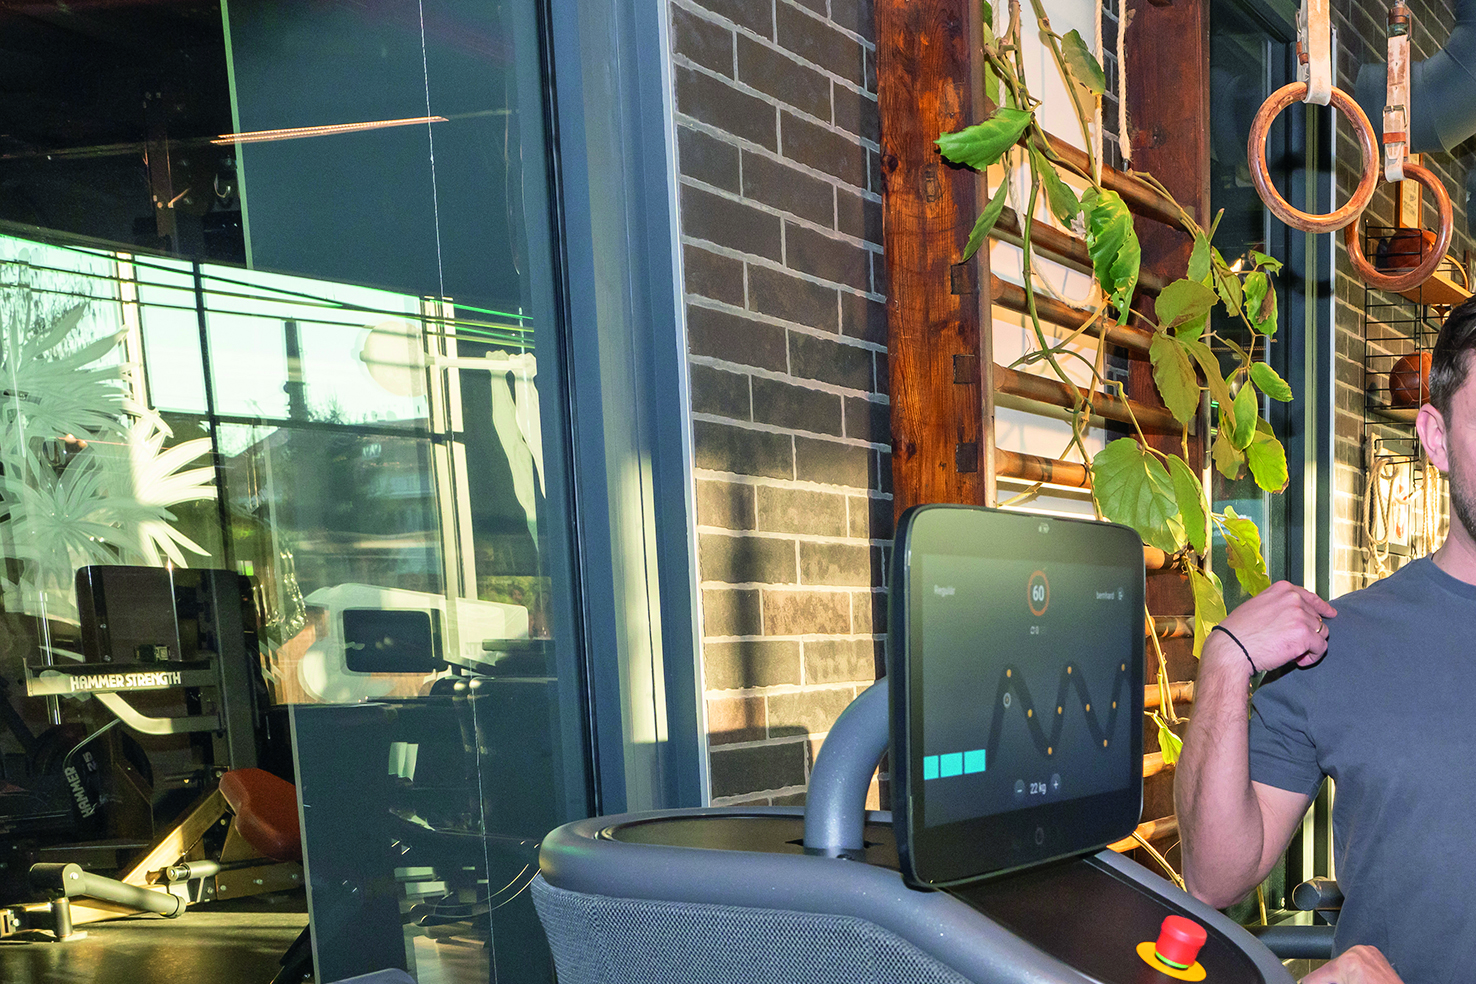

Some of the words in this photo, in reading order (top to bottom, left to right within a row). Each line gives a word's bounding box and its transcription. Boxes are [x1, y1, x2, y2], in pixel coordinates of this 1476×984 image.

[1032, 585, 1045, 602] 60
[70, 674, 124, 692] HAMMER
[125, 671, 181, 688] STRENGTH
[64, 766, 95, 818] HAMMER
